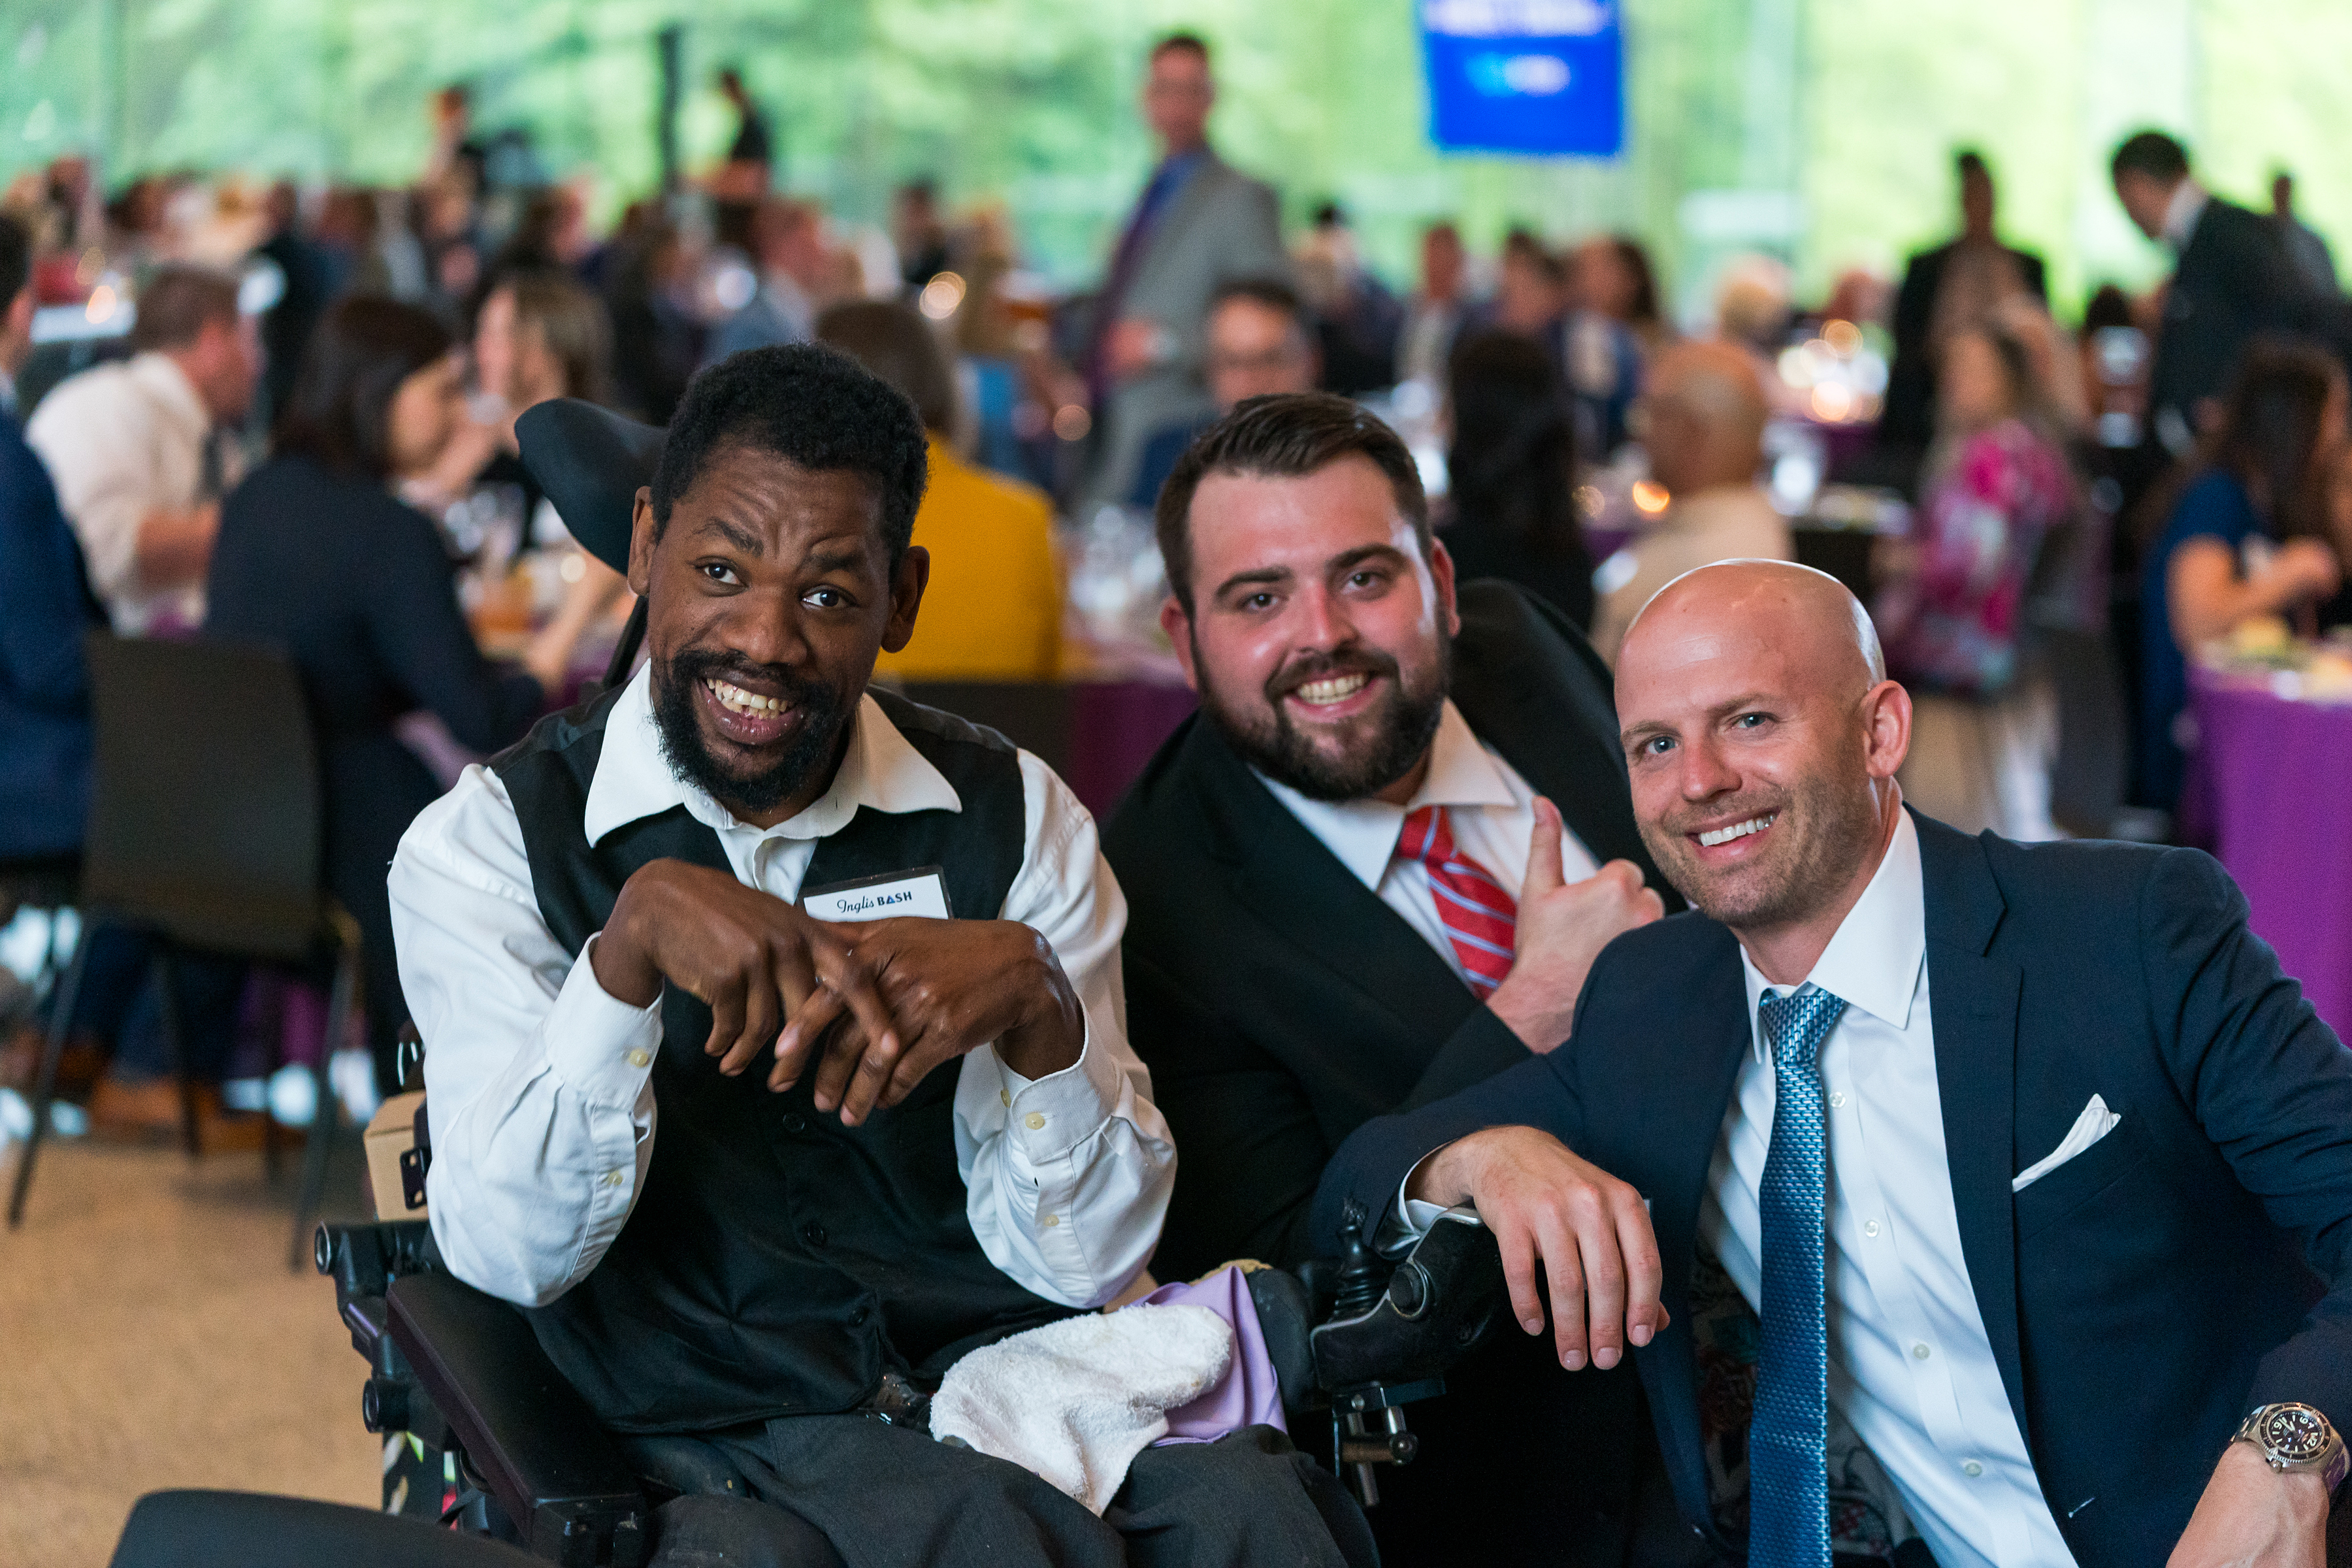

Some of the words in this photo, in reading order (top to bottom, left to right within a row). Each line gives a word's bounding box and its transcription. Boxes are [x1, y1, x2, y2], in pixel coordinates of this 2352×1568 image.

[837, 896, 874, 913] Inglis
[877, 891, 912, 906] BASH
[2274, 1422, 2283, 1430] 6
